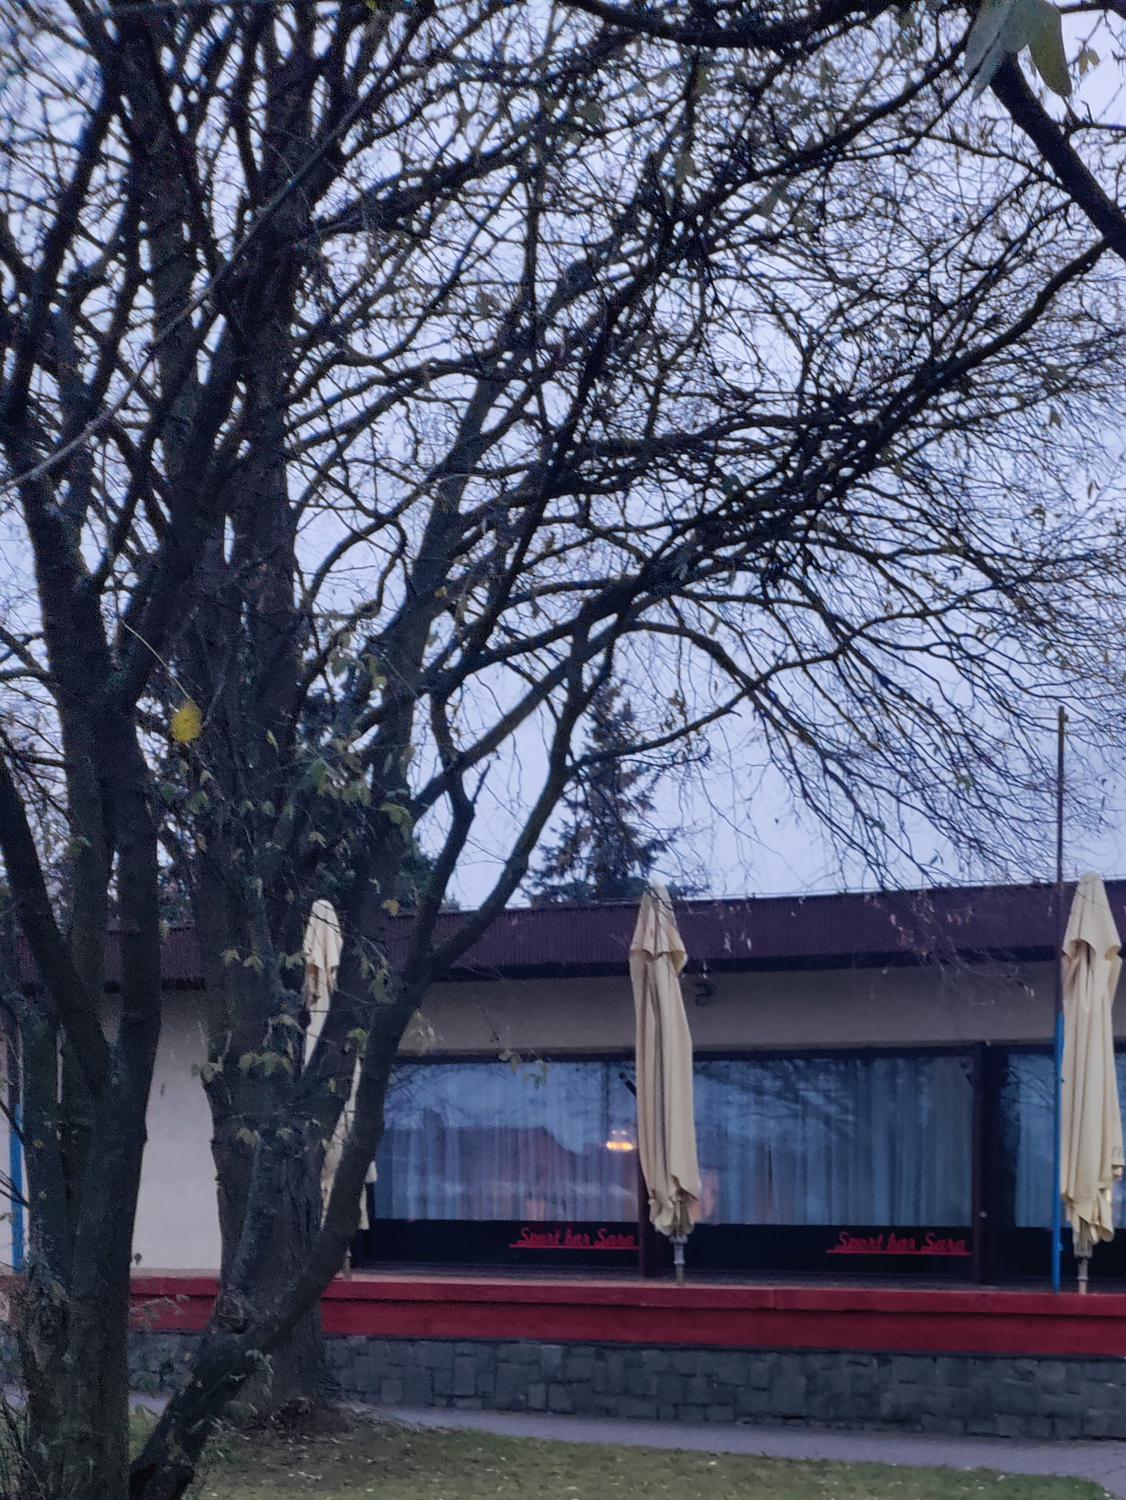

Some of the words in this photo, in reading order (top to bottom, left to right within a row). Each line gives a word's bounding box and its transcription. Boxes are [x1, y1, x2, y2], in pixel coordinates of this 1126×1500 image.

[516, 1227, 561, 1248] Sport
[594, 1228, 634, 1249] Sara
[835, 1231, 883, 1254] Sport
[886, 1232, 915, 1252] bar
[921, 1232, 966, 1254] Sara
